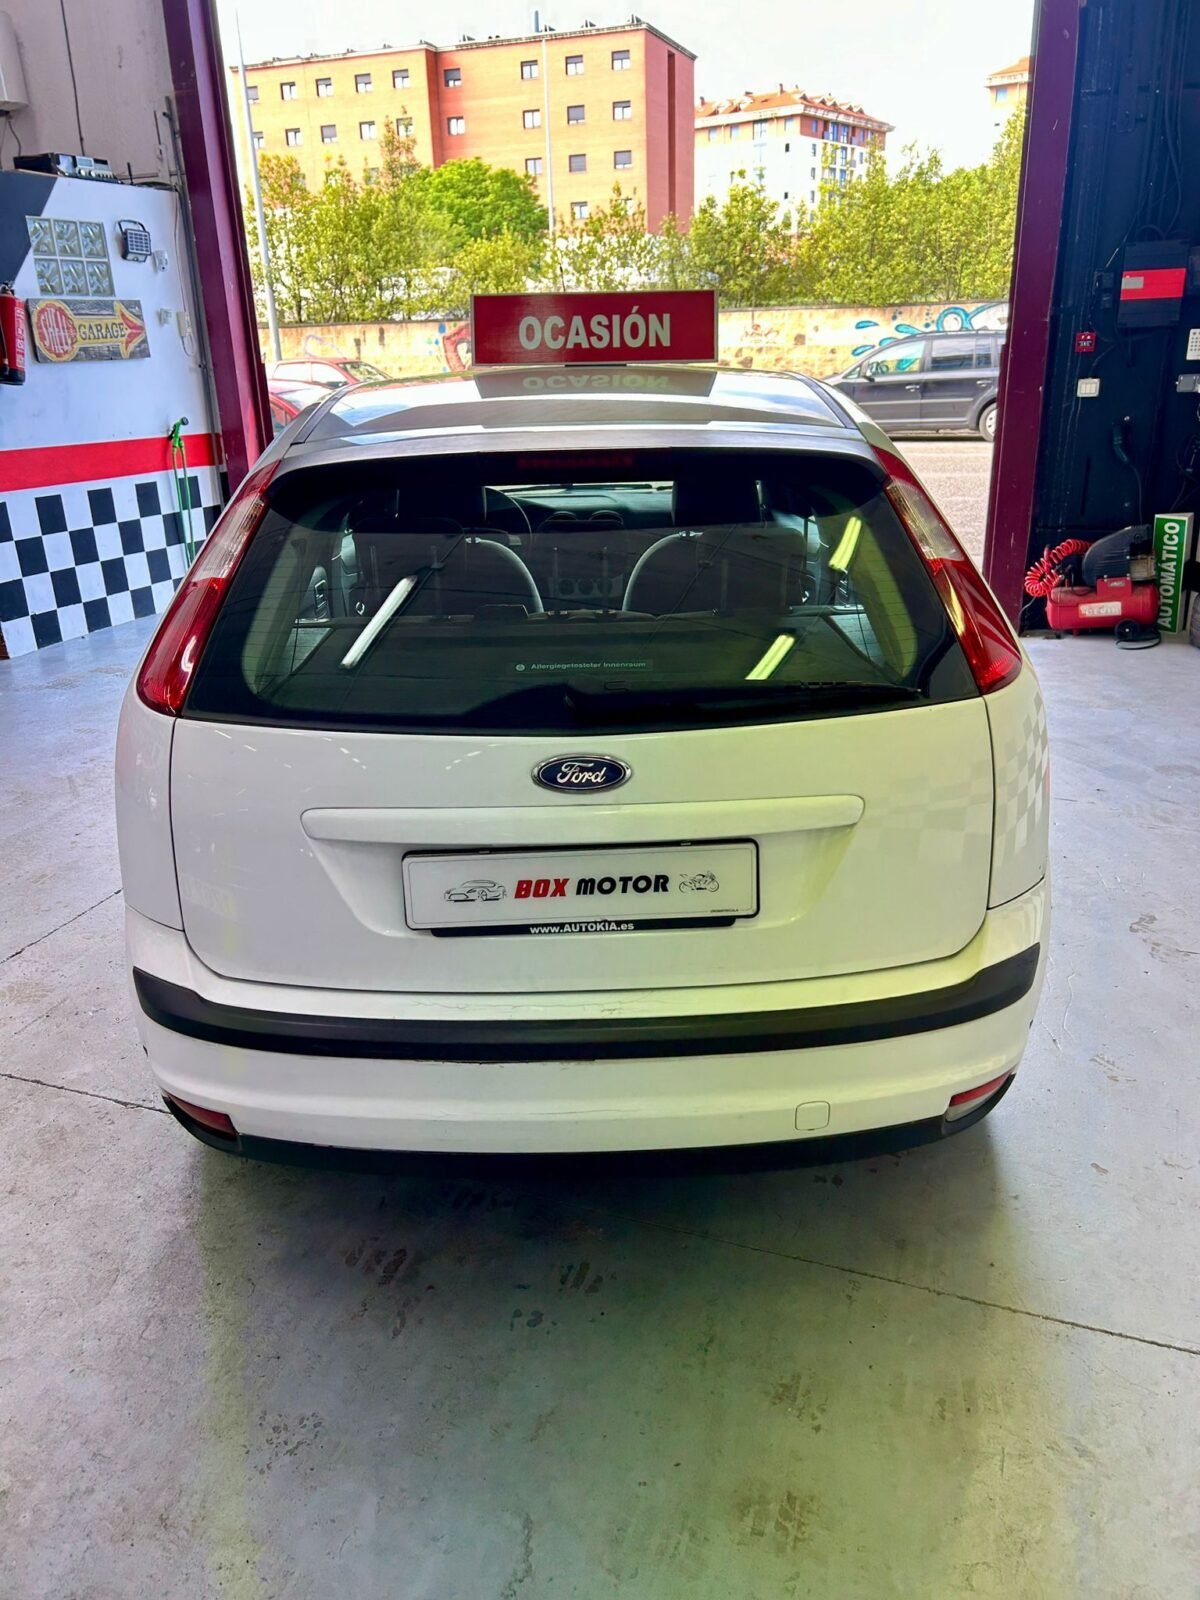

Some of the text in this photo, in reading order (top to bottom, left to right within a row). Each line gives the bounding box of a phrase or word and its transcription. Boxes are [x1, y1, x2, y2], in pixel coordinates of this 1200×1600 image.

[40, 307, 72, 354] SHELL
[78, 322, 126, 340] GARAGE
[518, 305, 671, 351] OCASIÓN
[1157, 521, 1180, 628] AUTOMÁTICO
[603, 661, 647, 670] Innenraum
[556, 761, 606, 784] Ford
[514, 874, 670, 899] BOX MOTOR
[529, 920, 635, 935] www.AUTOKIA.es
